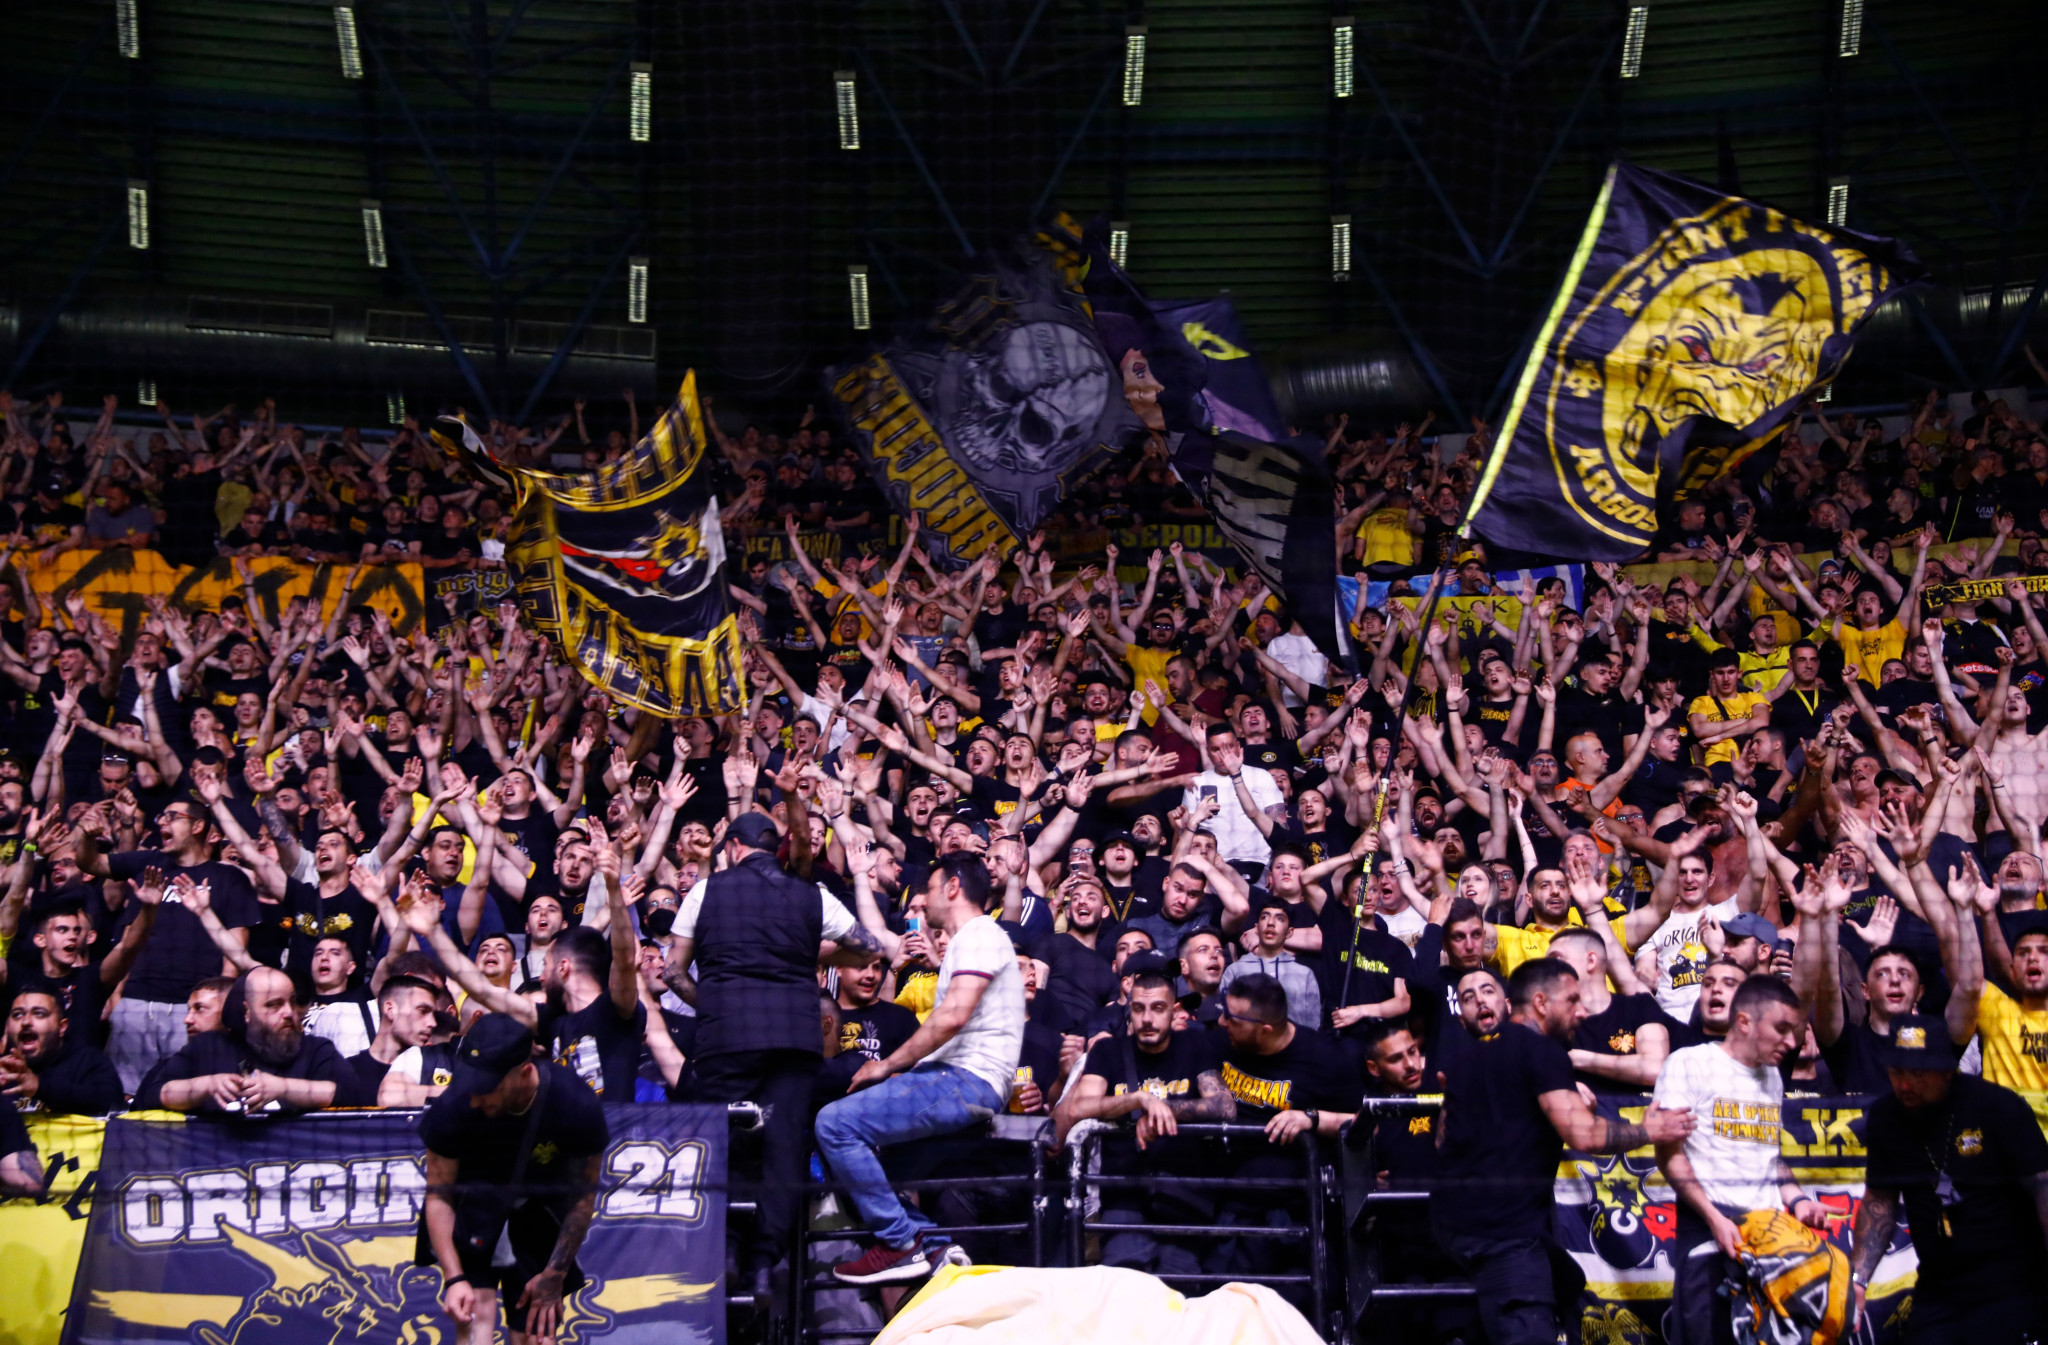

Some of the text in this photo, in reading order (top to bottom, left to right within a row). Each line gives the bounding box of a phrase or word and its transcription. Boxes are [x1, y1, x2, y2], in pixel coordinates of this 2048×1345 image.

[1119, 522, 1232, 549] SEPOL
[1963, 581, 2005, 600] FIGH
[1664, 925, 1700, 948] ORIGI
[120, 1142, 703, 1244] ORIGIN 21
